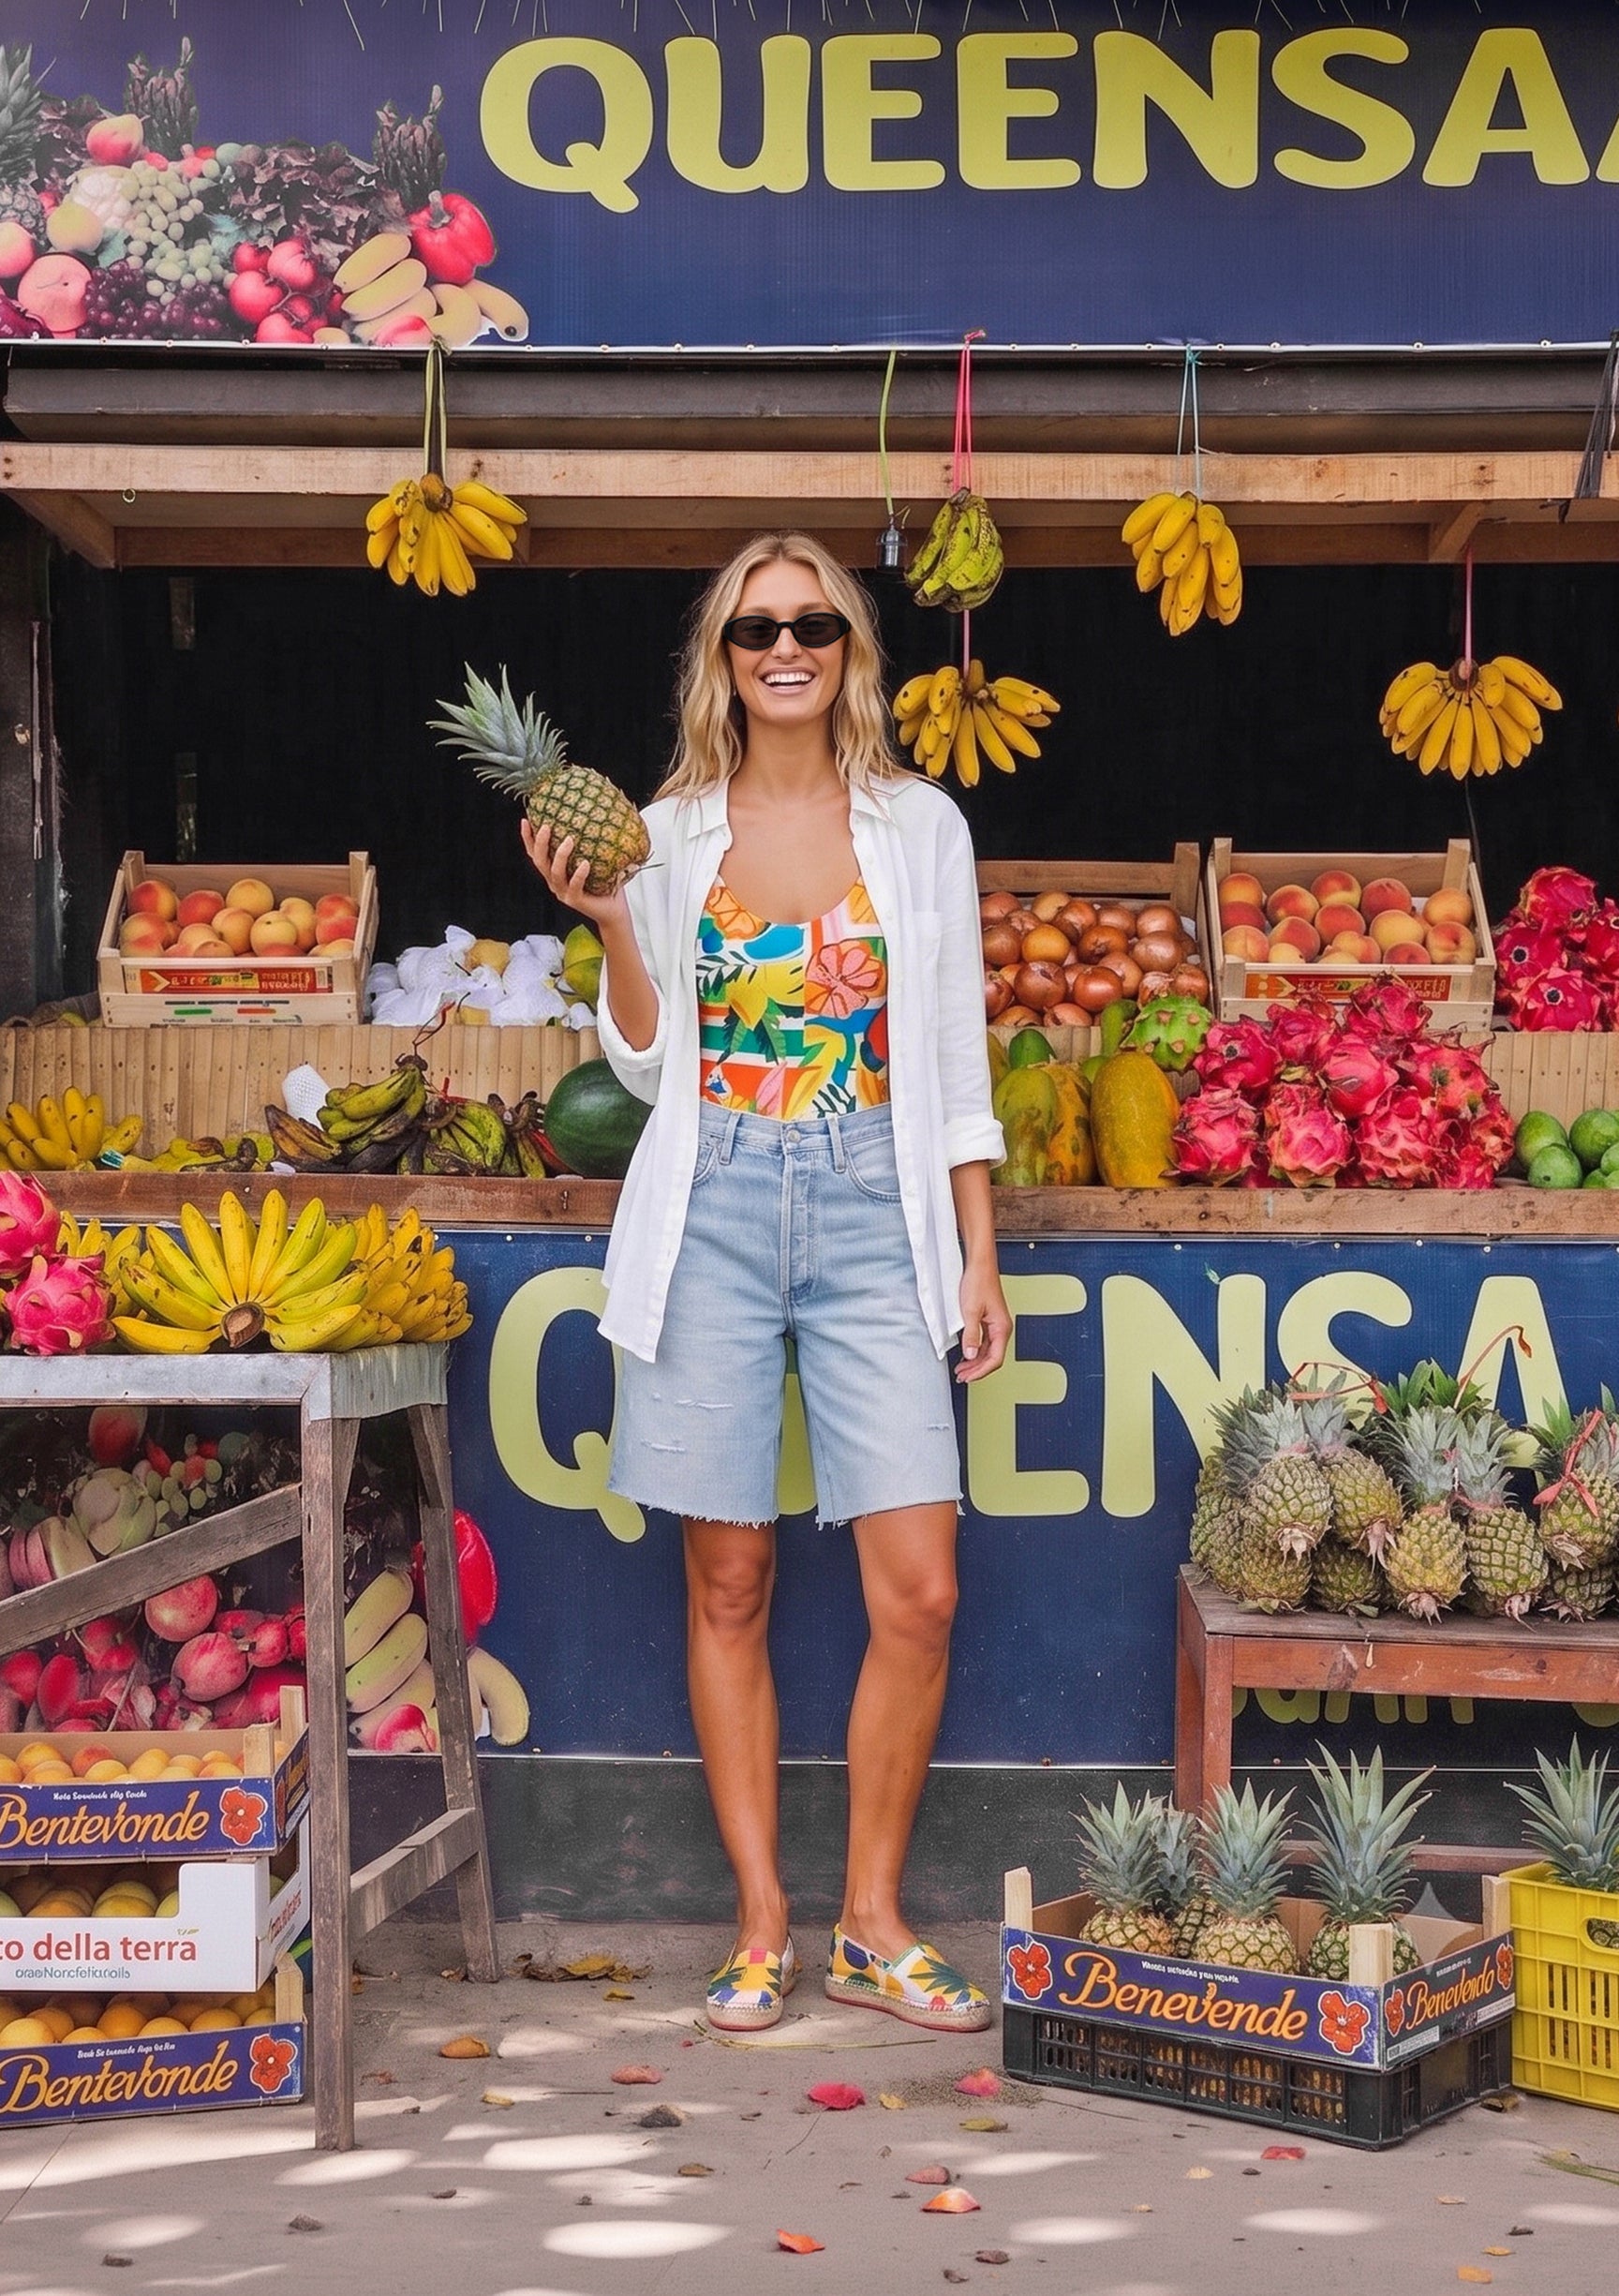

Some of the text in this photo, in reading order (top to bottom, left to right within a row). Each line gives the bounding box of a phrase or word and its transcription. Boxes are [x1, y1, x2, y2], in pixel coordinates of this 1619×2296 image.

[480, 27, 1619, 213] QUEENSA
[34, 1932, 111, 1961] della
[120, 1936, 197, 1961] terra
